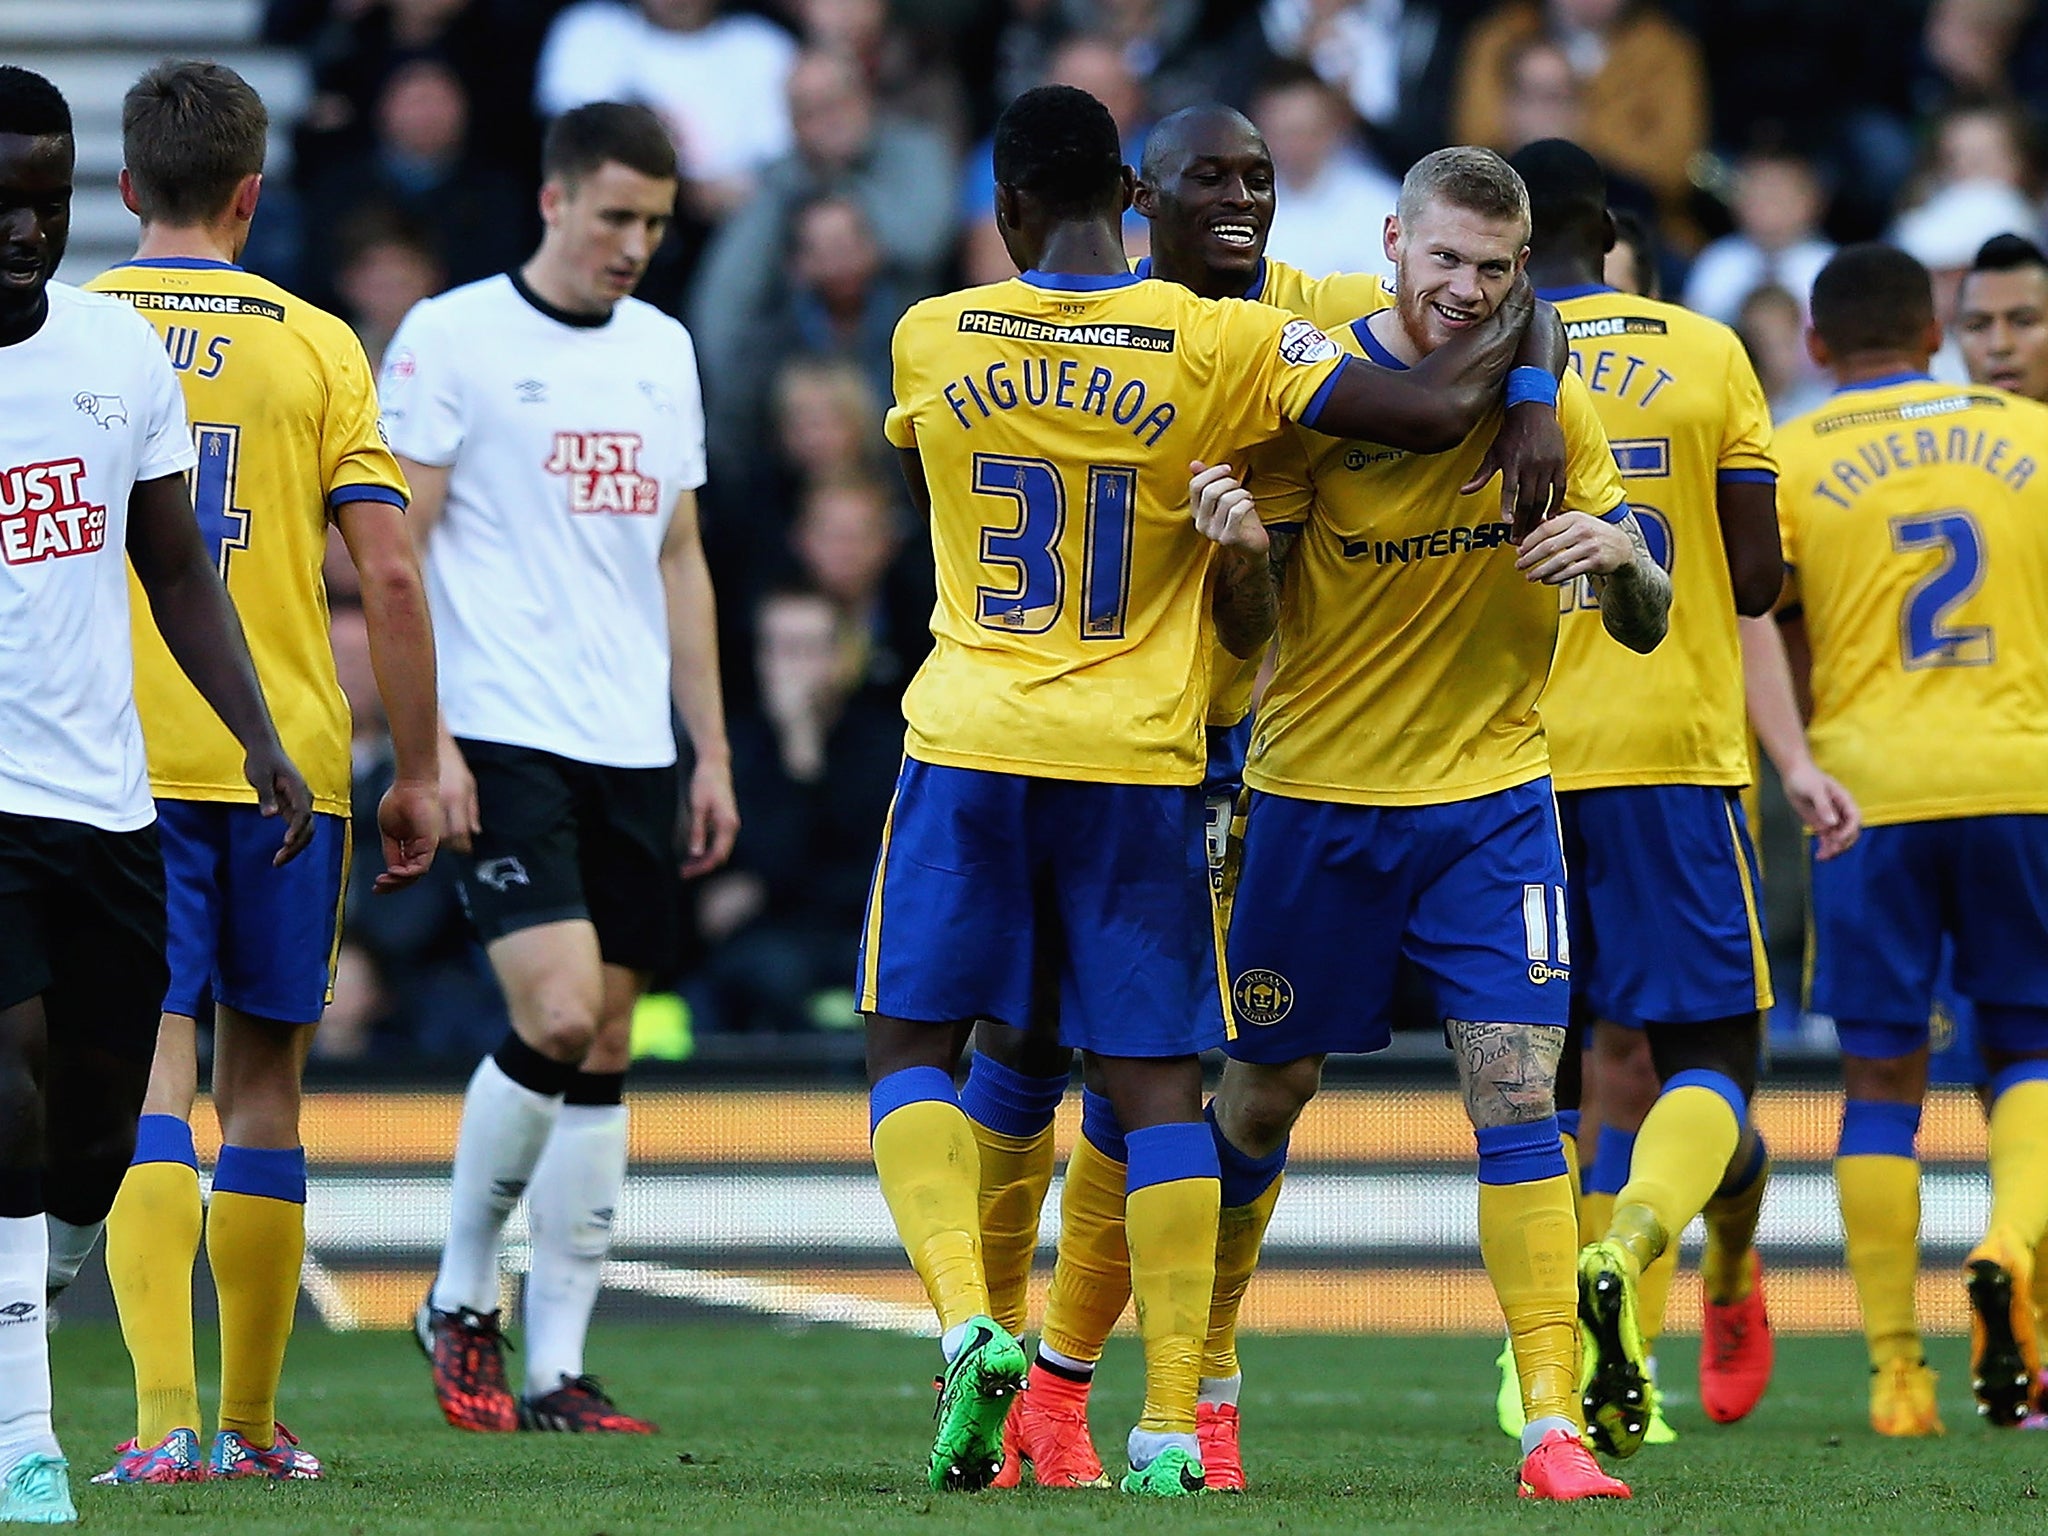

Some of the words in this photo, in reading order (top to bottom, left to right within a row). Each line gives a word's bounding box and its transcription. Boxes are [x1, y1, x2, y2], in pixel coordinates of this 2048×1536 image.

[165, 326, 232, 379] WS
[961, 313, 1170, 351] PREMIERRANGE.CO.UK
[944, 358, 1177, 447] FIGUEROA
[549, 436, 638, 472] JUST
[1813, 426, 2036, 509] TAVERNIER
[574, 474, 641, 509] EAT
[2, 508, 87, 561] EAT
[972, 452, 1138, 640] 31
[1374, 523, 1518, 565] INTERSP
[1888, 507, 1996, 673] 2
[1523, 884, 1570, 965] 11
